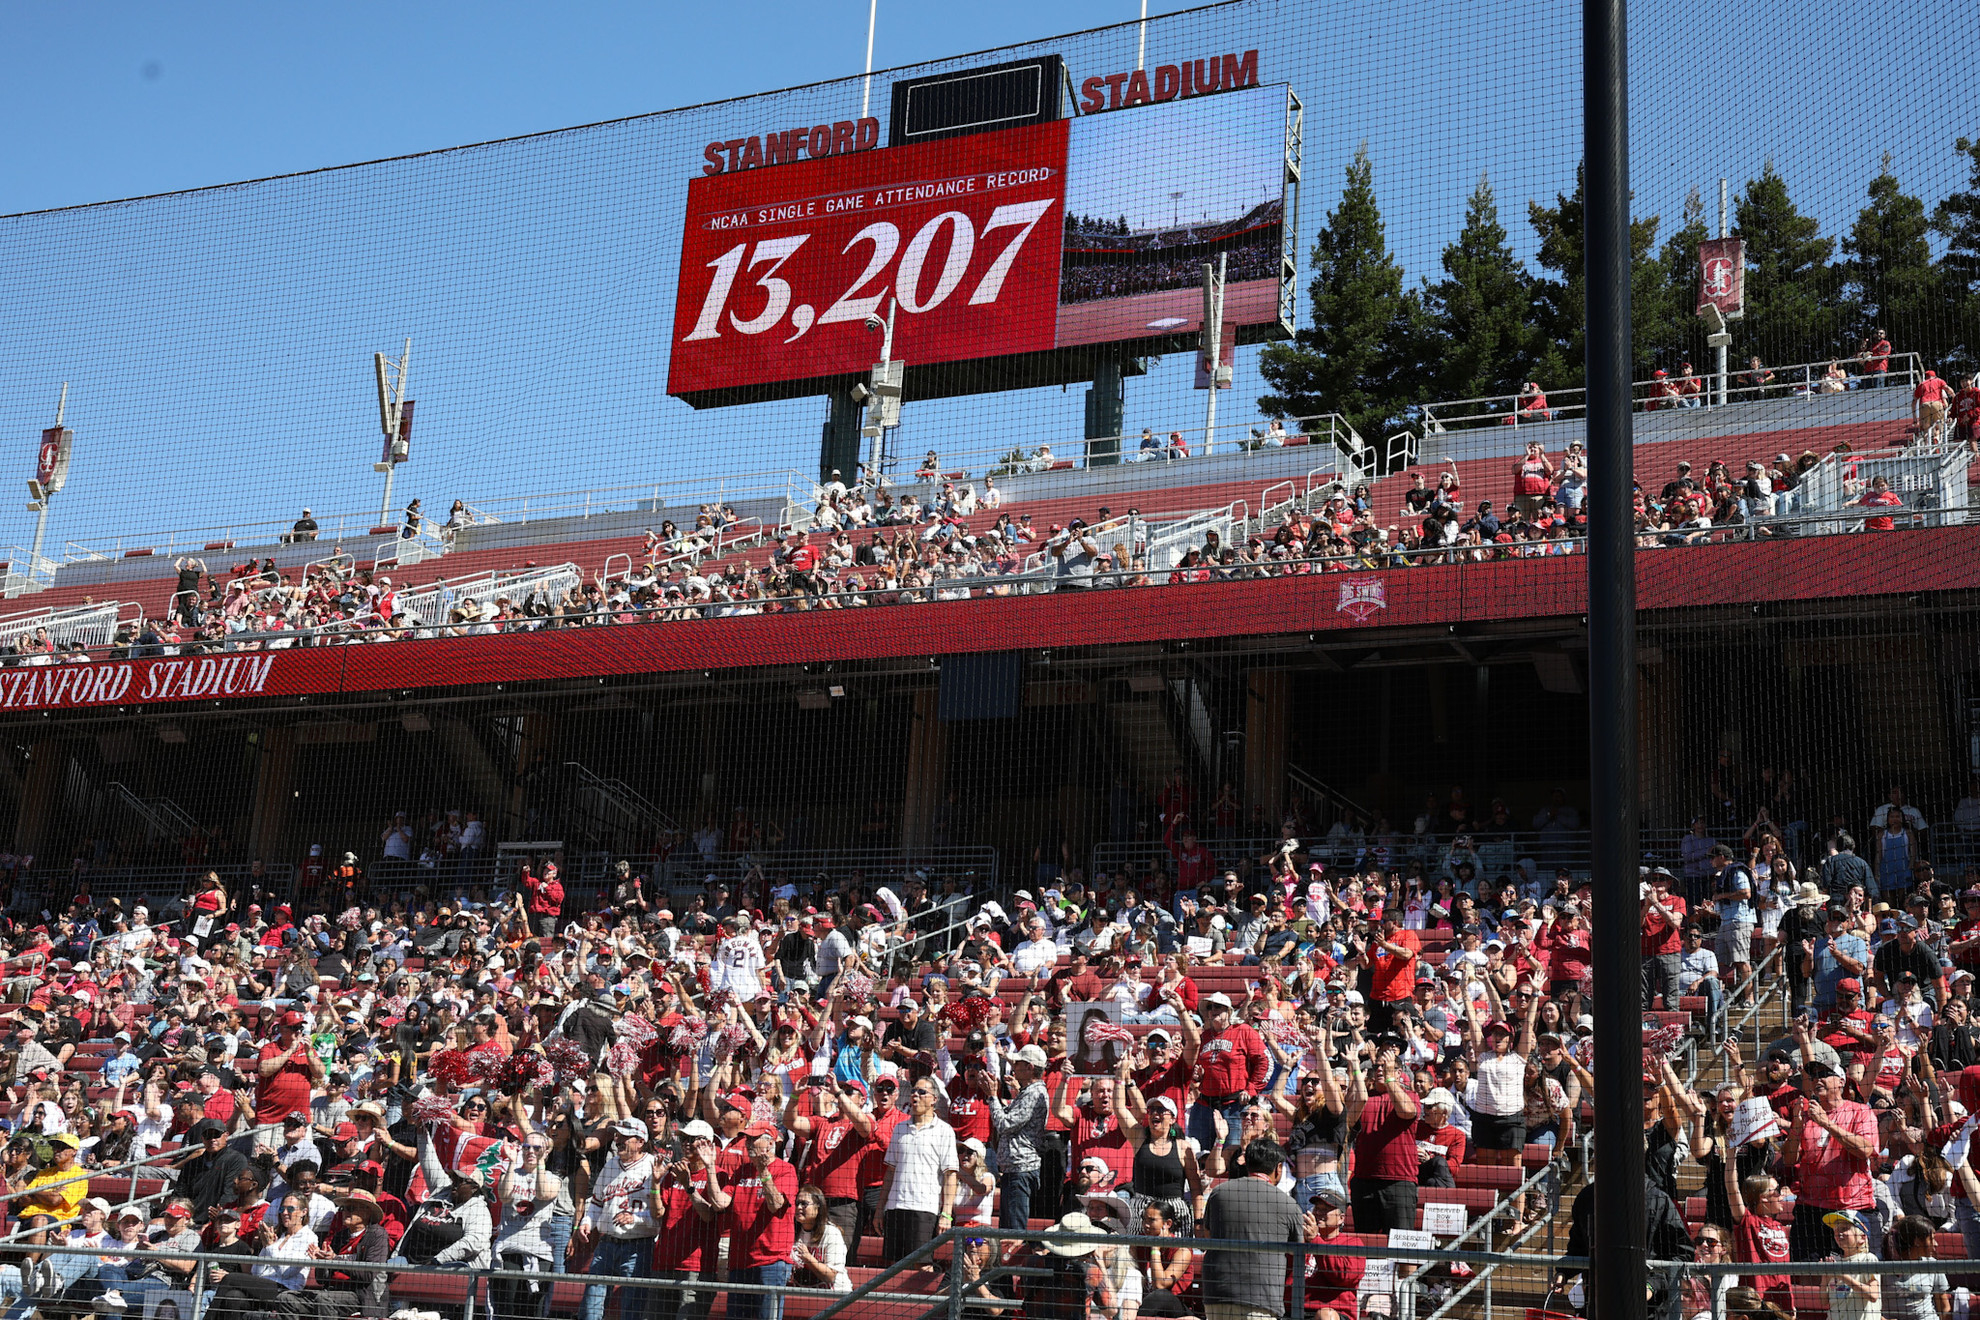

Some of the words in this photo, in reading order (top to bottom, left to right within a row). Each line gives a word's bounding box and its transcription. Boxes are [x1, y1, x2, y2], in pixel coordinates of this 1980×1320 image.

[703, 117, 879, 176] STANFORD
[1080, 49, 1259, 113] STADIUM
[711, 213, 748, 230] NCAA
[758, 202, 815, 223] SINGLE
[826, 195, 864, 212] GAME
[875, 179, 975, 206] ATTENDANCE
[987, 167, 1050, 191] RECORD
[682, 198, 1056, 344] 13,207
[141, 655, 277, 699] STADIUM
[733, 949, 745, 967] 2
[1393, 1234, 1427, 1242] RESERVED
